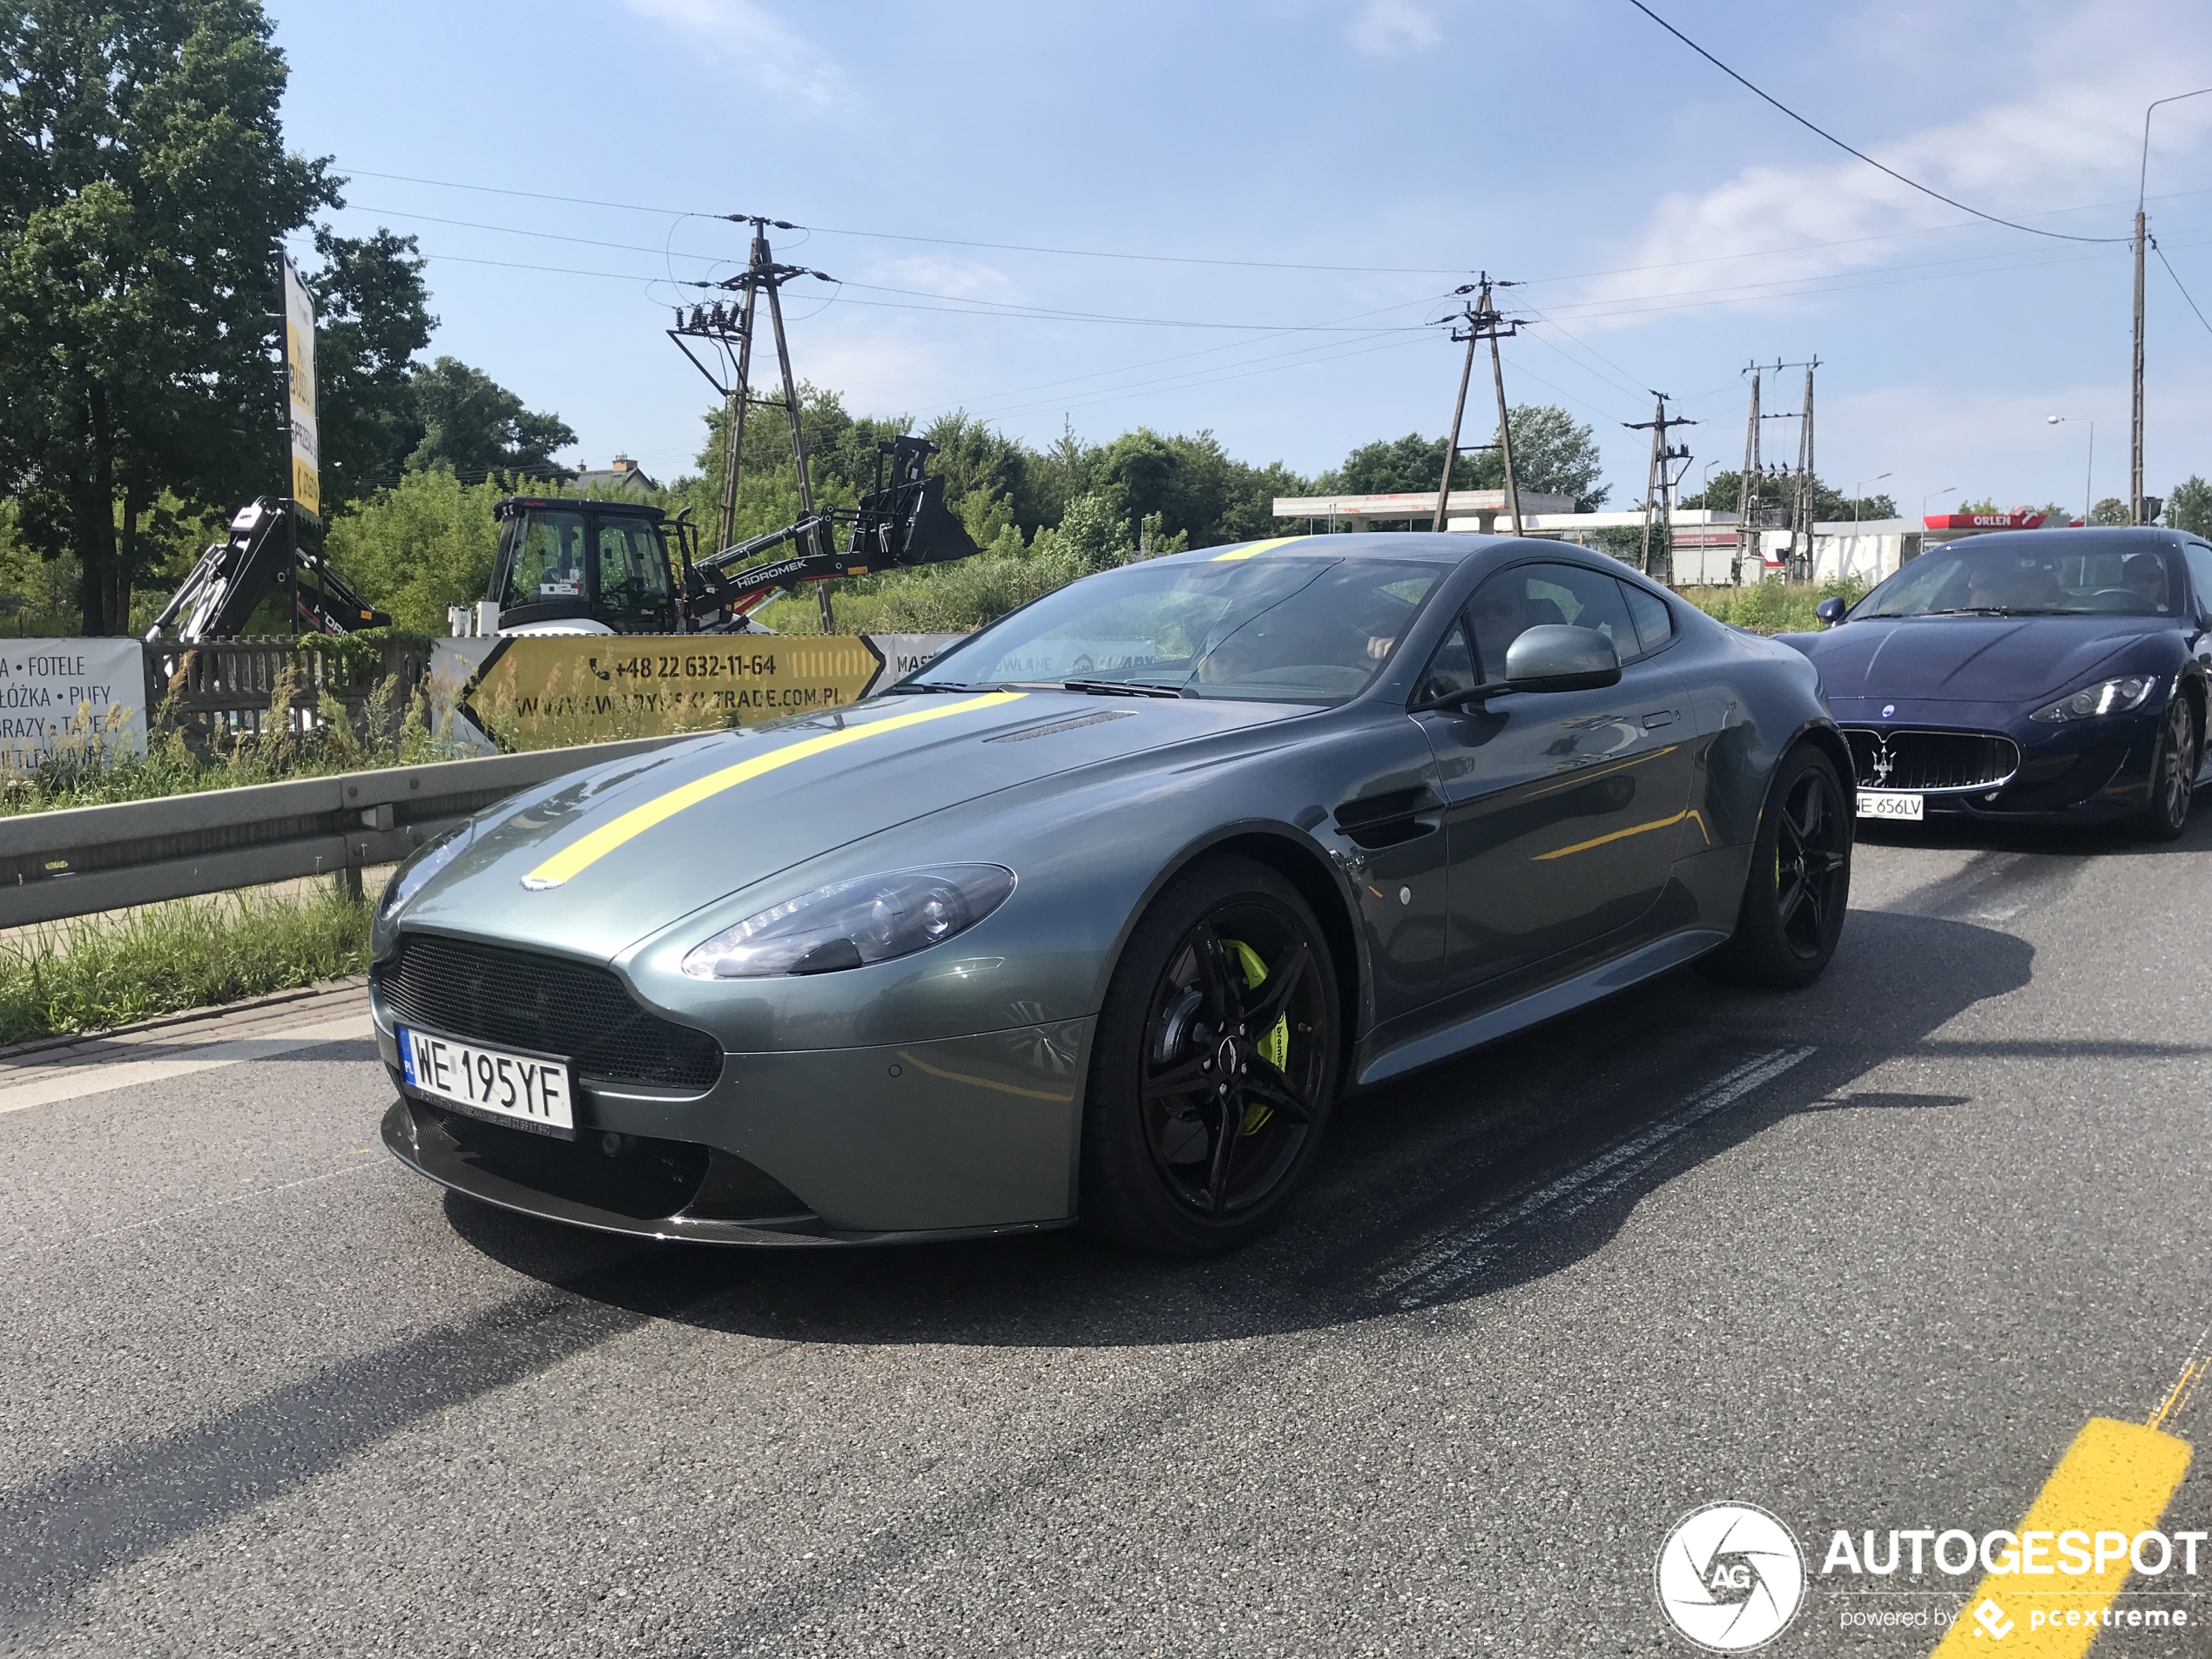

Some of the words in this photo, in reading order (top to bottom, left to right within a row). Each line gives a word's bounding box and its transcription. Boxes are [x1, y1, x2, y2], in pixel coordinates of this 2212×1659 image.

[1973, 516, 2012, 526] ORLEN
[29, 656, 85, 677] FOTELE
[616, 657, 651, 678] +48
[658, 656, 680, 678] 22
[685, 655, 777, 678] 632-11-64
[70, 685, 111, 706] PUFY
[1877, 799, 1921, 815] 656LV
[403, 1060, 415, 1075] PL
[414, 1035, 452, 1092] WE
[462, 1049, 560, 1117] 195YF
